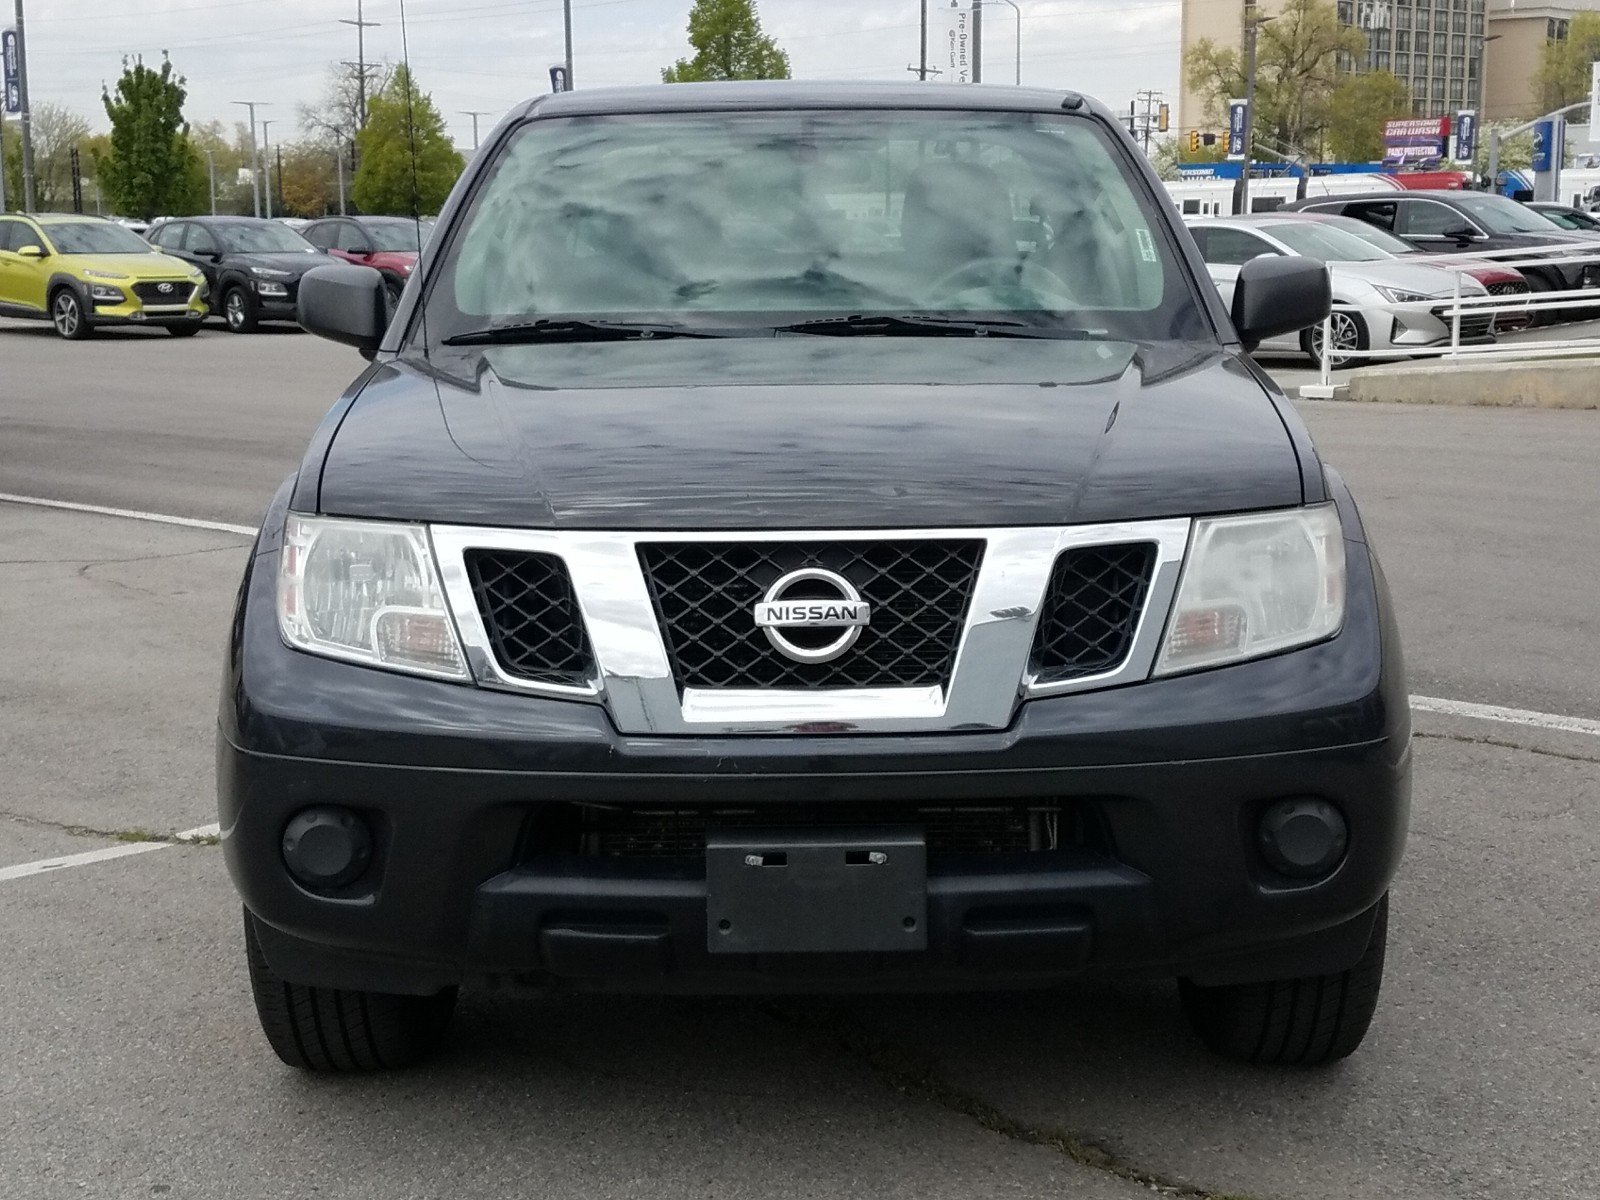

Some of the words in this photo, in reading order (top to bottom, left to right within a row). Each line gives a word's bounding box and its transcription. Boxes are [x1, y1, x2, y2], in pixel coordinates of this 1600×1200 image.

[959, 13, 968, 66] Pre-Owned
[1385, 128, 1406, 136] CAR
[1407, 127, 1440, 135] WASH
[1404, 146, 1437, 156] PROTECTION
[766, 605, 858, 621] NISSAN
